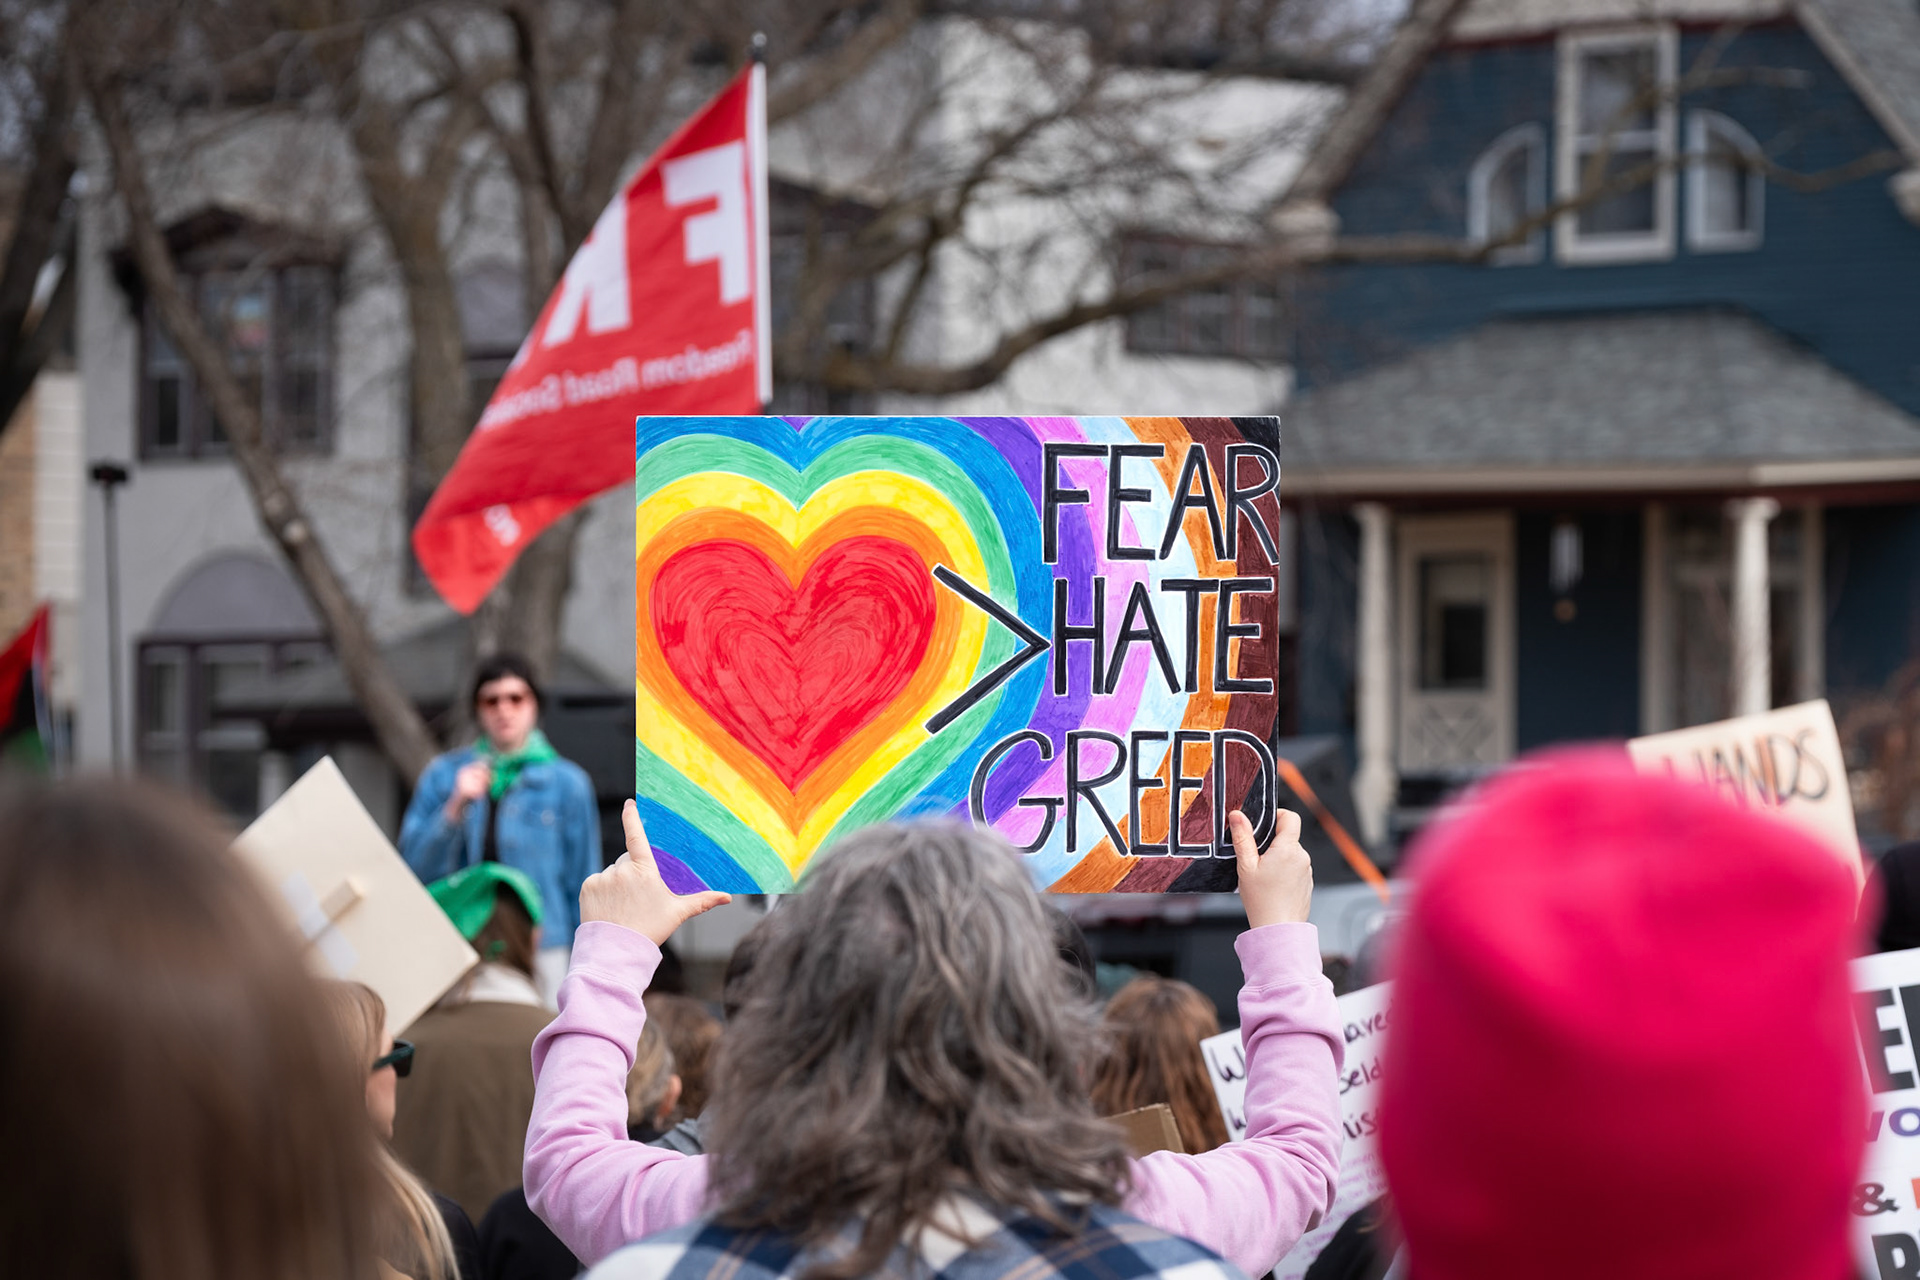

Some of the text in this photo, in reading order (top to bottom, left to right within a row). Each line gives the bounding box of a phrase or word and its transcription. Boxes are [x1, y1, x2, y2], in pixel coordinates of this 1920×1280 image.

[1042, 442, 1280, 564] FEAR
[1053, 575, 1275, 695] HATE
[968, 728, 1279, 859] GREED
